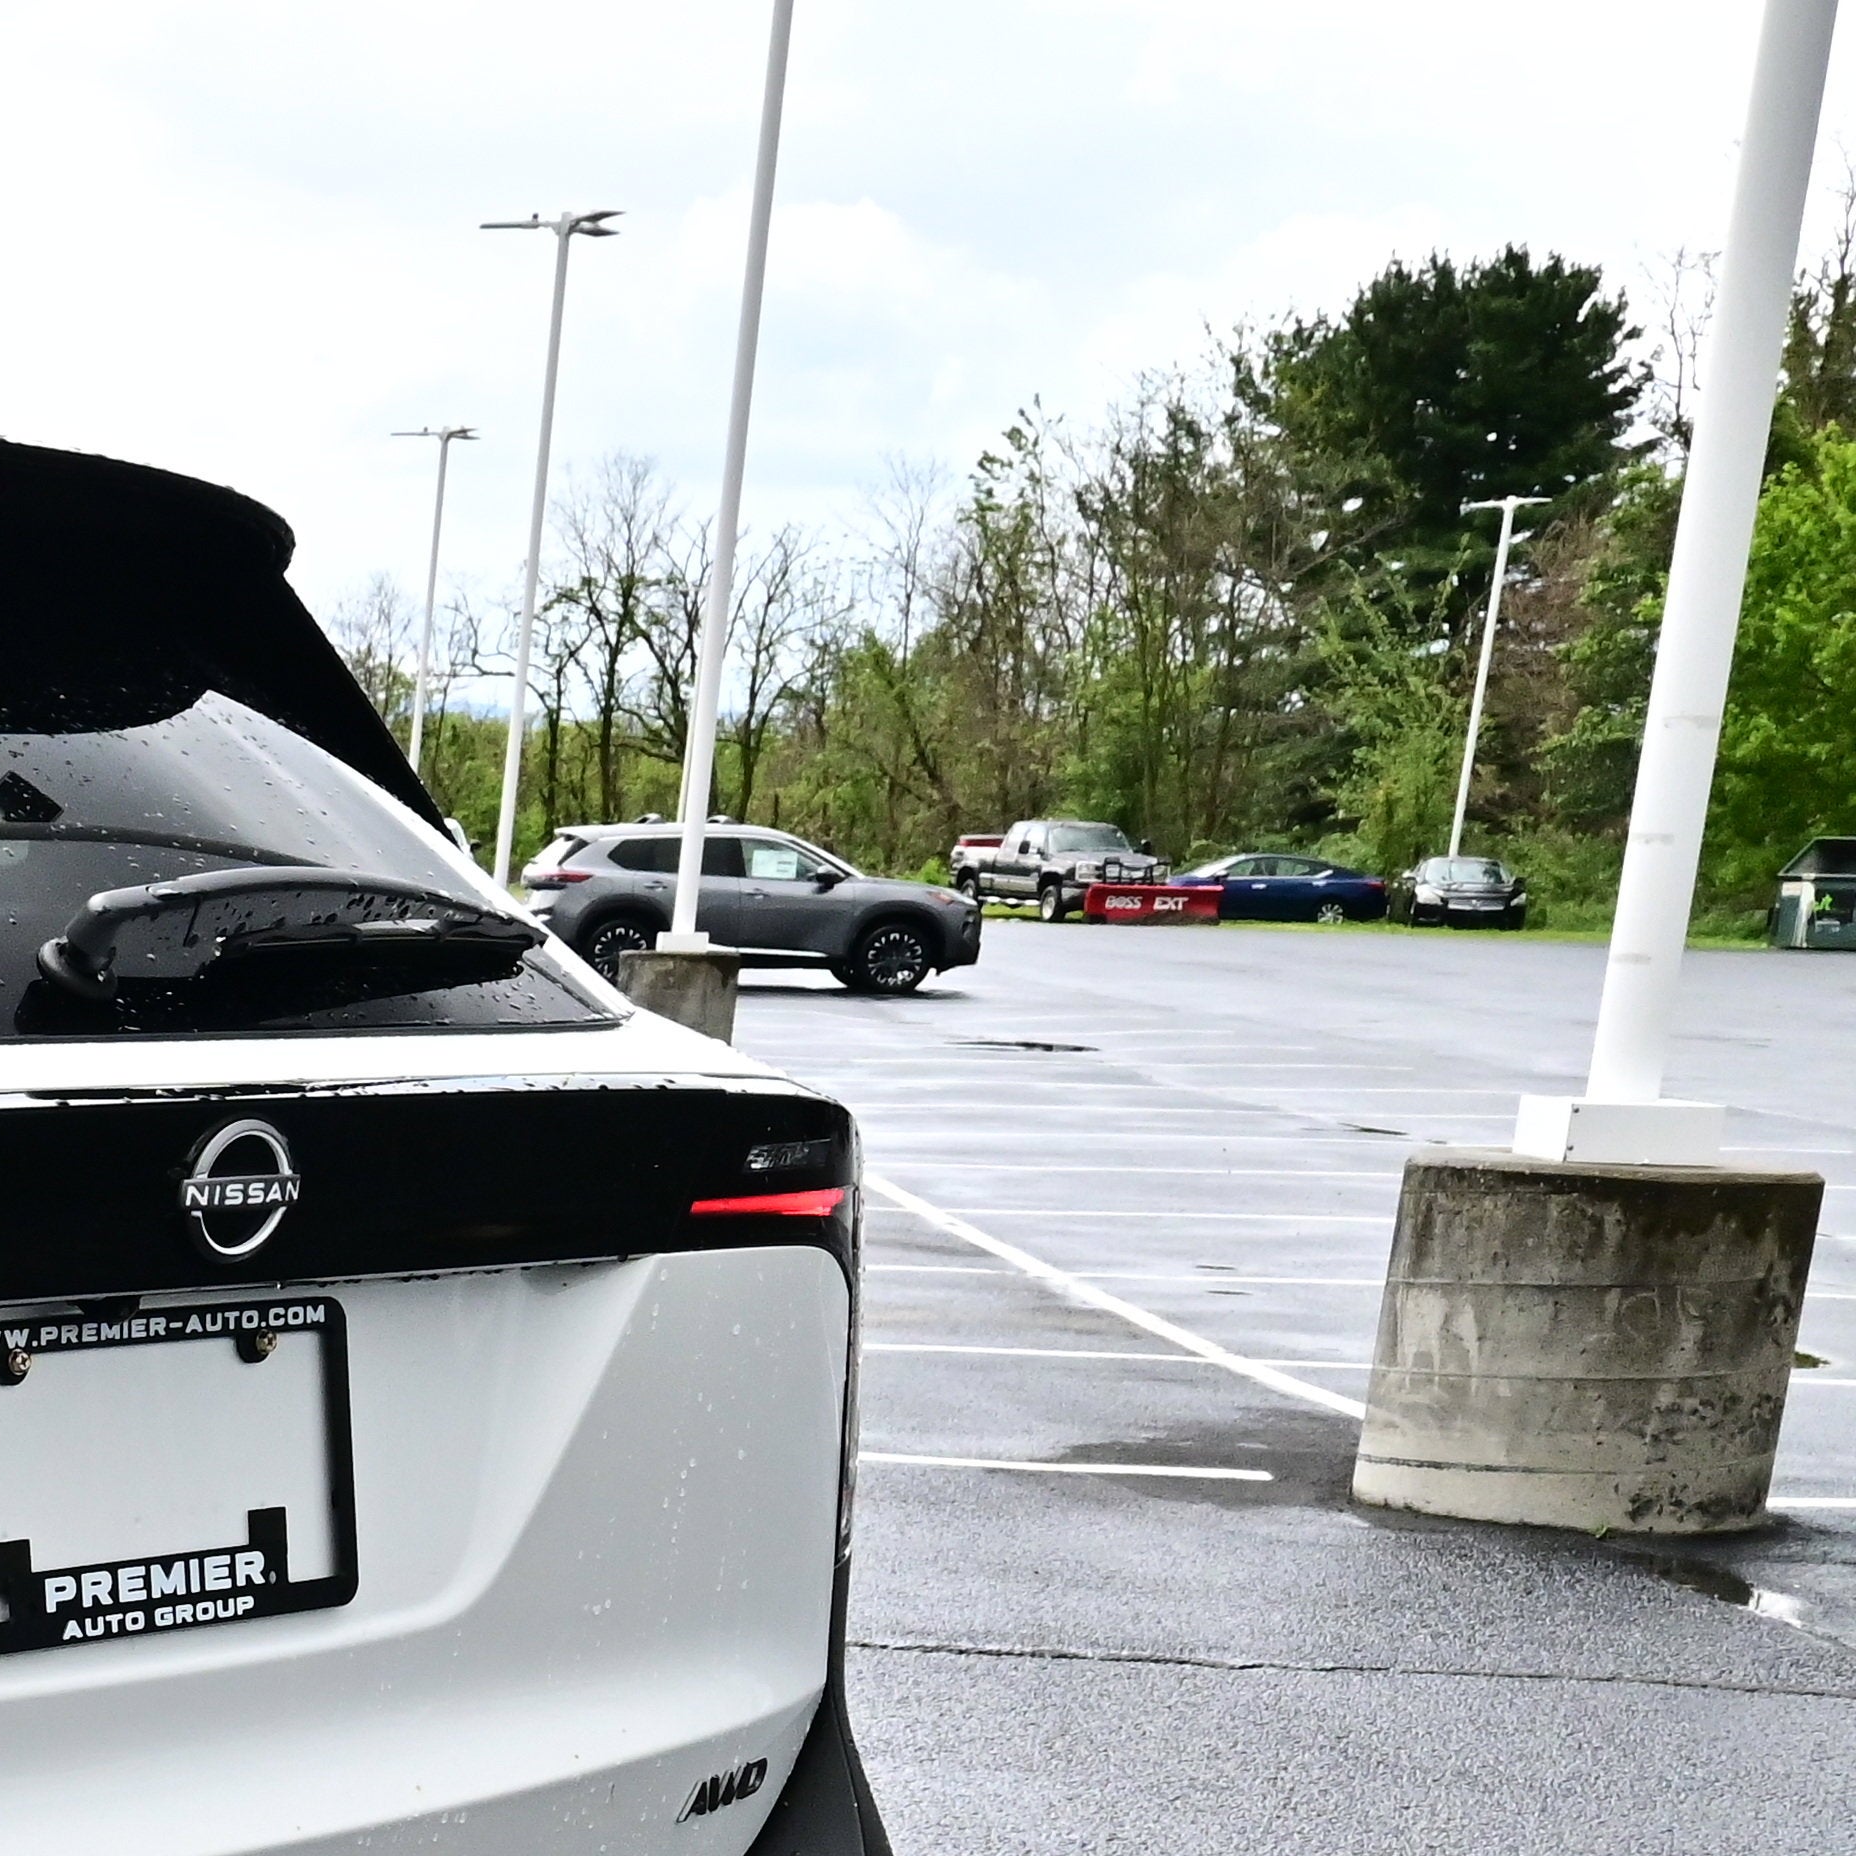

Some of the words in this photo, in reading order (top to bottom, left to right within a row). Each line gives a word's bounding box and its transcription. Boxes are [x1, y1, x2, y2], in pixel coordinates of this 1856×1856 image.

[1104, 895, 1143, 910] BOSS
[1153, 896, 1189, 911] EXT
[185, 1180, 301, 1207] NISSAN
[44, 1550, 266, 1614] PREMIER
[62, 1611, 145, 1641] AUTO
[154, 1596, 255, 1627] GROUP
[675, 1756, 768, 1824] AWD
